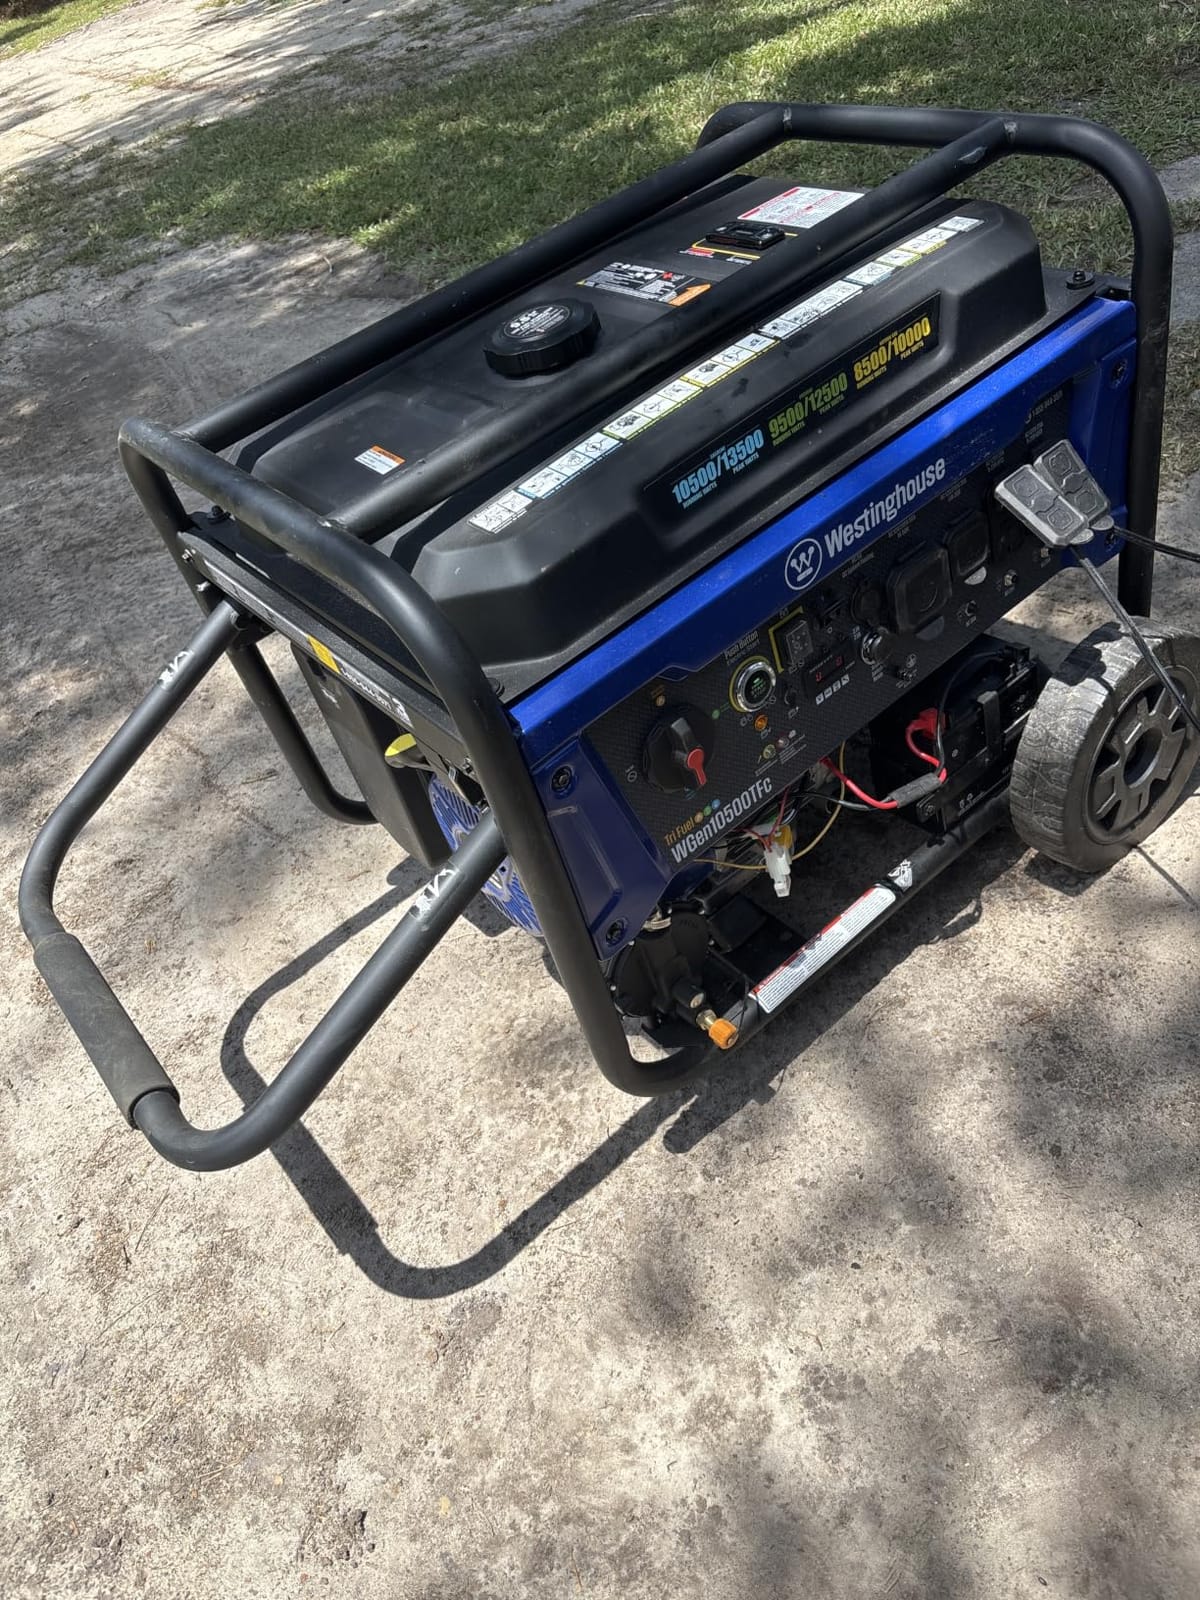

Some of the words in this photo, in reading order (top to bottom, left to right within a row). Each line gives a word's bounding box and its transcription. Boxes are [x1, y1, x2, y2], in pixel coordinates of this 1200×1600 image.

[853, 317, 931, 382] 8500/10000
[768, 372, 848, 439] 9500/12500
[671, 428, 765, 504] 10500/13500
[824, 457, 946, 558] Westinghouse
[664, 829, 677, 847] Tri
[675, 816, 695, 838] Fuel
[671, 777, 773, 864] WGen10500TFC
